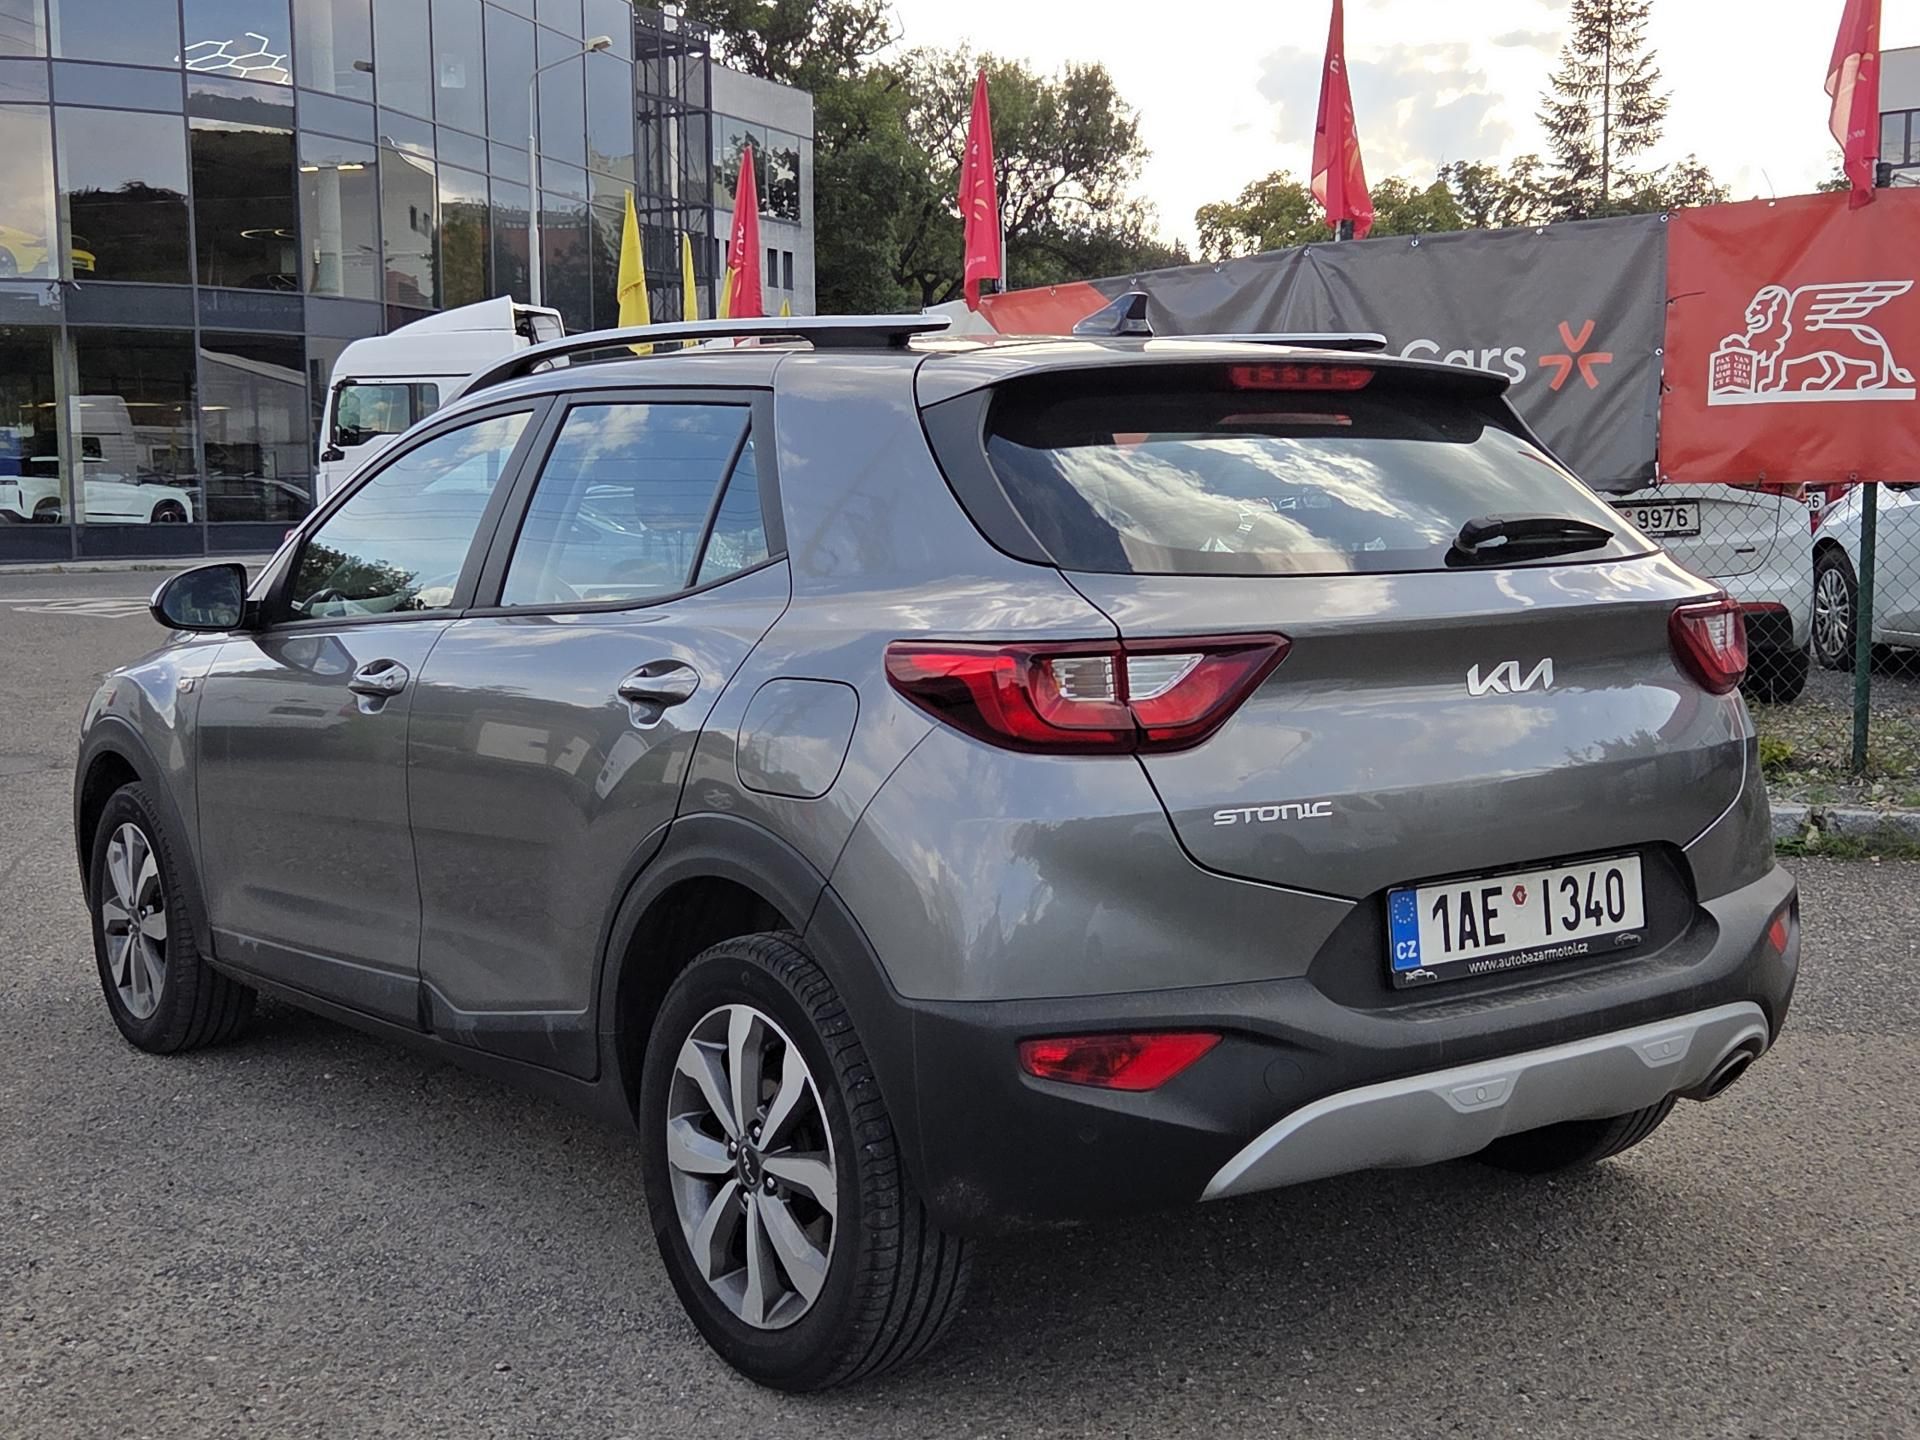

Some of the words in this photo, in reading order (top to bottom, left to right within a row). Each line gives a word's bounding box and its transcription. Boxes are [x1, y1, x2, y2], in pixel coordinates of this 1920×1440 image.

[1637, 508, 1689, 529] 9976
[1466, 657, 1554, 696] KIA
[1213, 801, 1333, 826] STONIC
[1432, 886, 1506, 953] 1AE
[1396, 940, 1418, 960] CZ
[1468, 942, 1589, 974] www.autobazarmotol.cz
